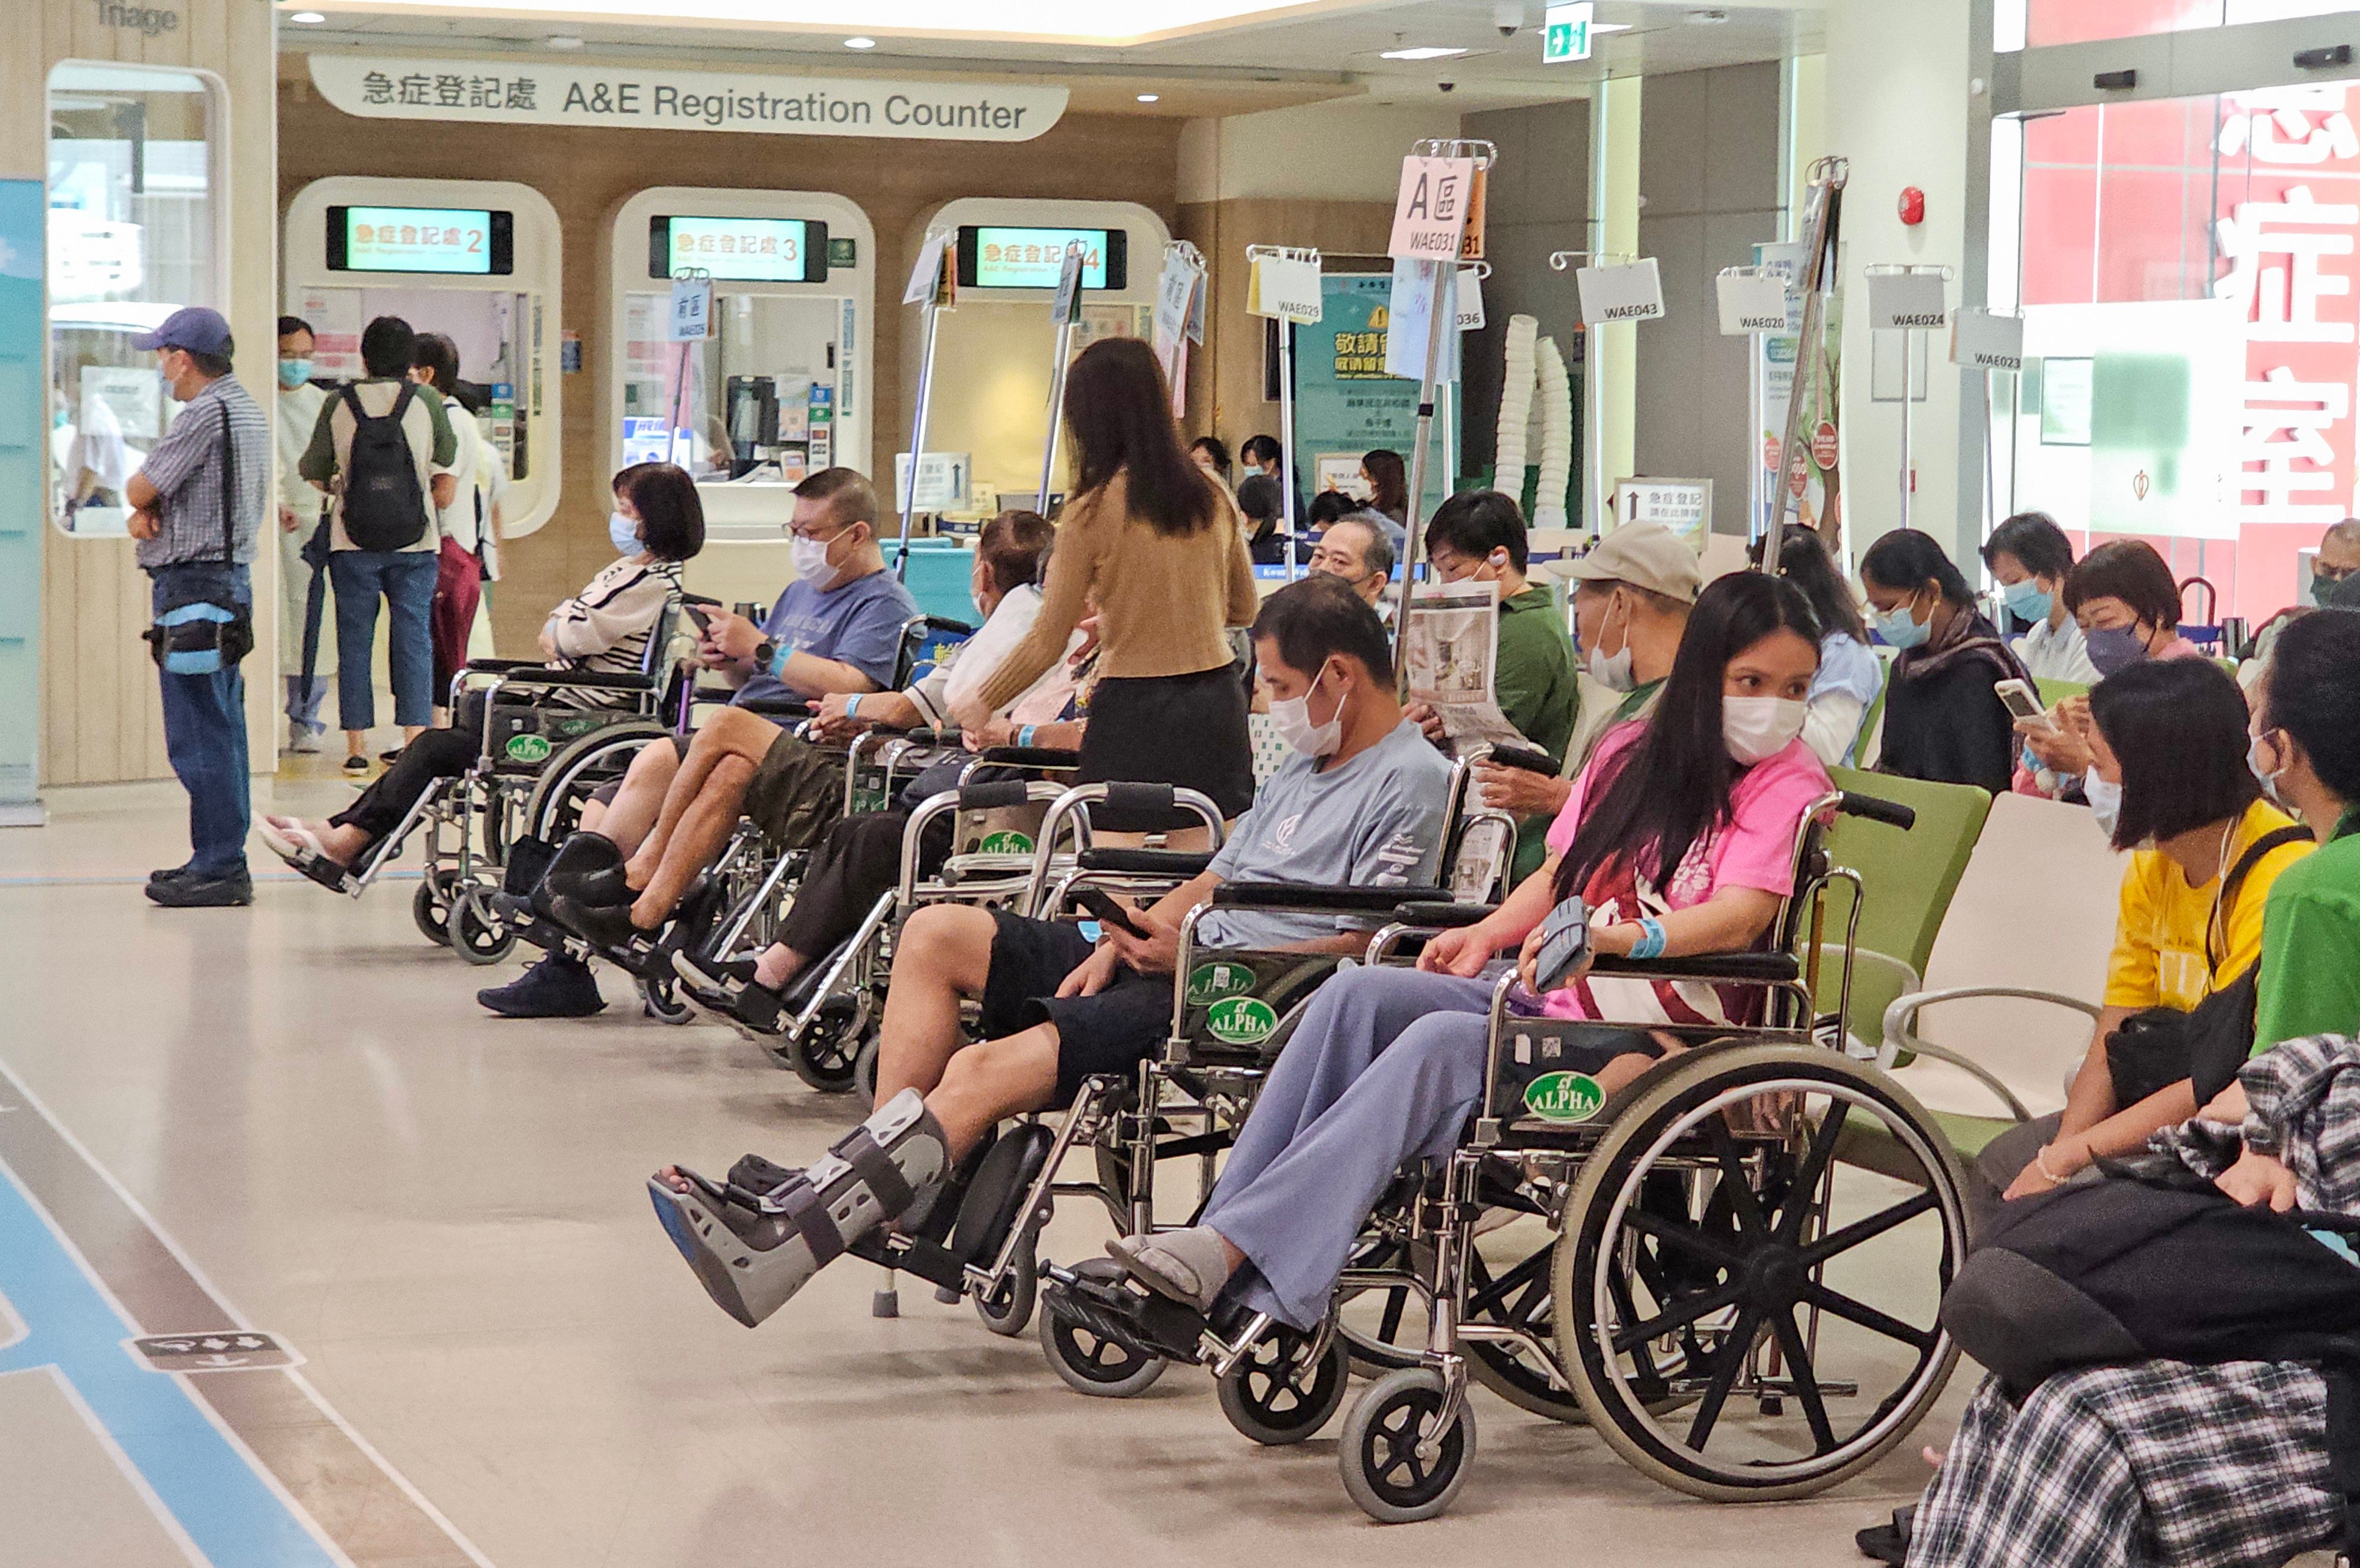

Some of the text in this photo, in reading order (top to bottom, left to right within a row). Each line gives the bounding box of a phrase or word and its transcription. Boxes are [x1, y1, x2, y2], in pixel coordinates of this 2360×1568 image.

[93, 0, 177, 37] Triage
[362, 70, 537, 110] 急症登記處
[563, 81, 1027, 129] A&E Registration Counter
[466, 229, 483, 253] 2
[783, 239, 798, 261] 3
[1409, 231, 1455, 251] WAE031
[1461, 234, 1480, 254] 31
[984, 243, 1100, 270] 急症登記 4
[1278, 300, 1320, 317] WAE029
[1604, 303, 1659, 319] WAE043
[1739, 317, 1785, 329] WAE020
[1892, 313, 1945, 326] WAE024
[1974, 352, 2022, 370] WAE023
[1211, 1012, 1268, 1034] ALPHA
[1532, 1089, 1595, 1110] ALPHA
